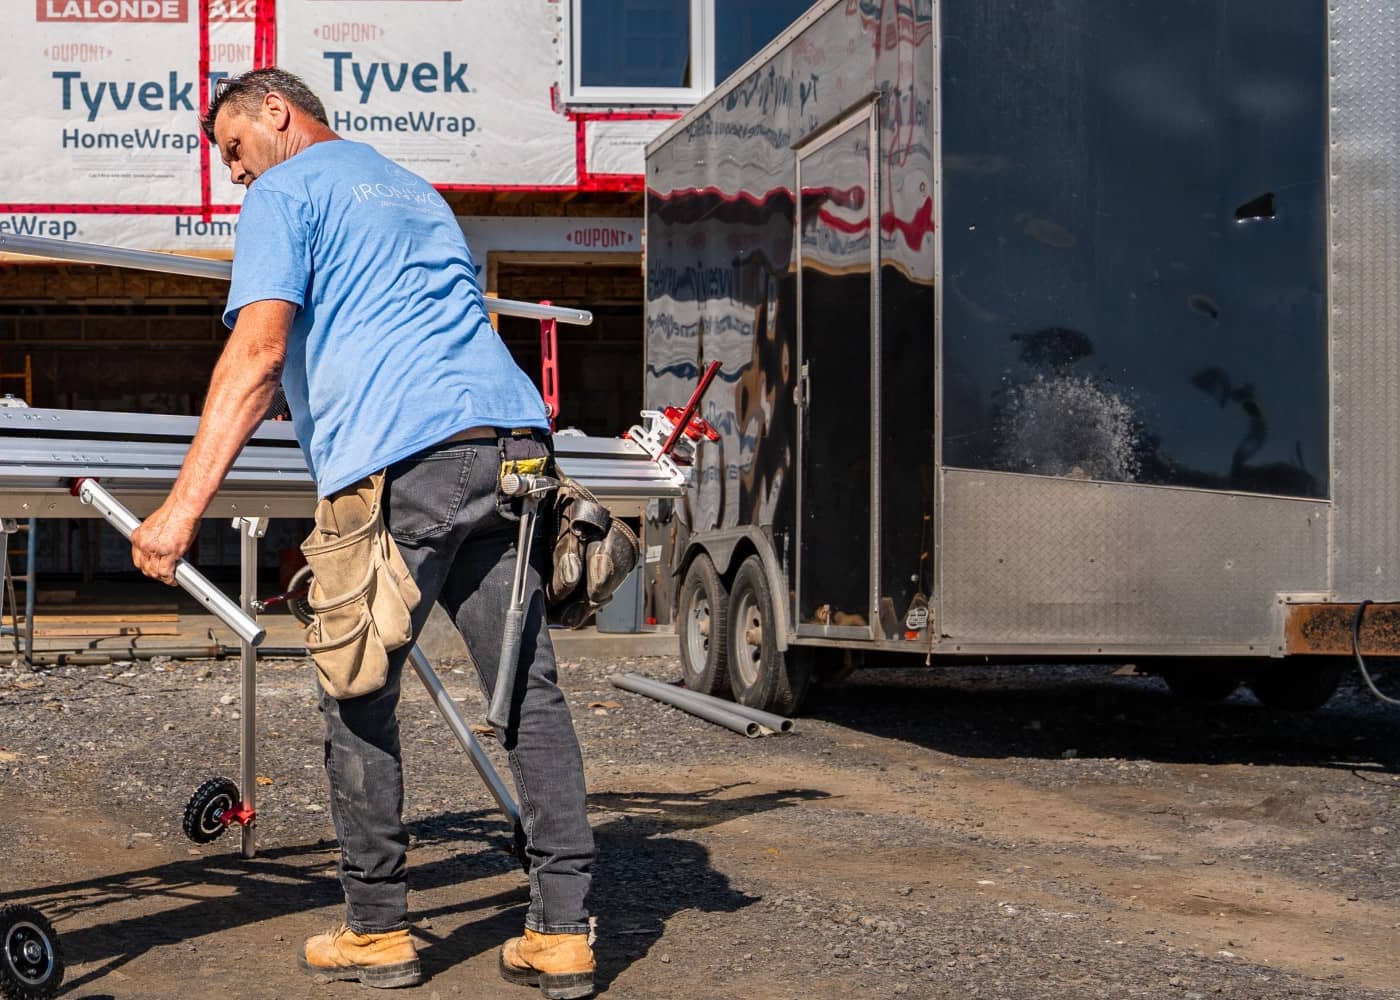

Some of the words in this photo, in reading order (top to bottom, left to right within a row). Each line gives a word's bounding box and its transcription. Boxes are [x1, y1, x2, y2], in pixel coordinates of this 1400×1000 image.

[46, 0, 180, 18] LALONDE
[322, 22, 377, 42] DUPONT
[51, 43, 105, 62] DUPONT
[323, 51, 470, 104] Tyvek
[52, 71, 195, 122] Tyvek
[334, 111, 476, 137] HomeWrap
[63, 129, 199, 153] HomeWrap
[574, 228, 626, 248] DUPONT
